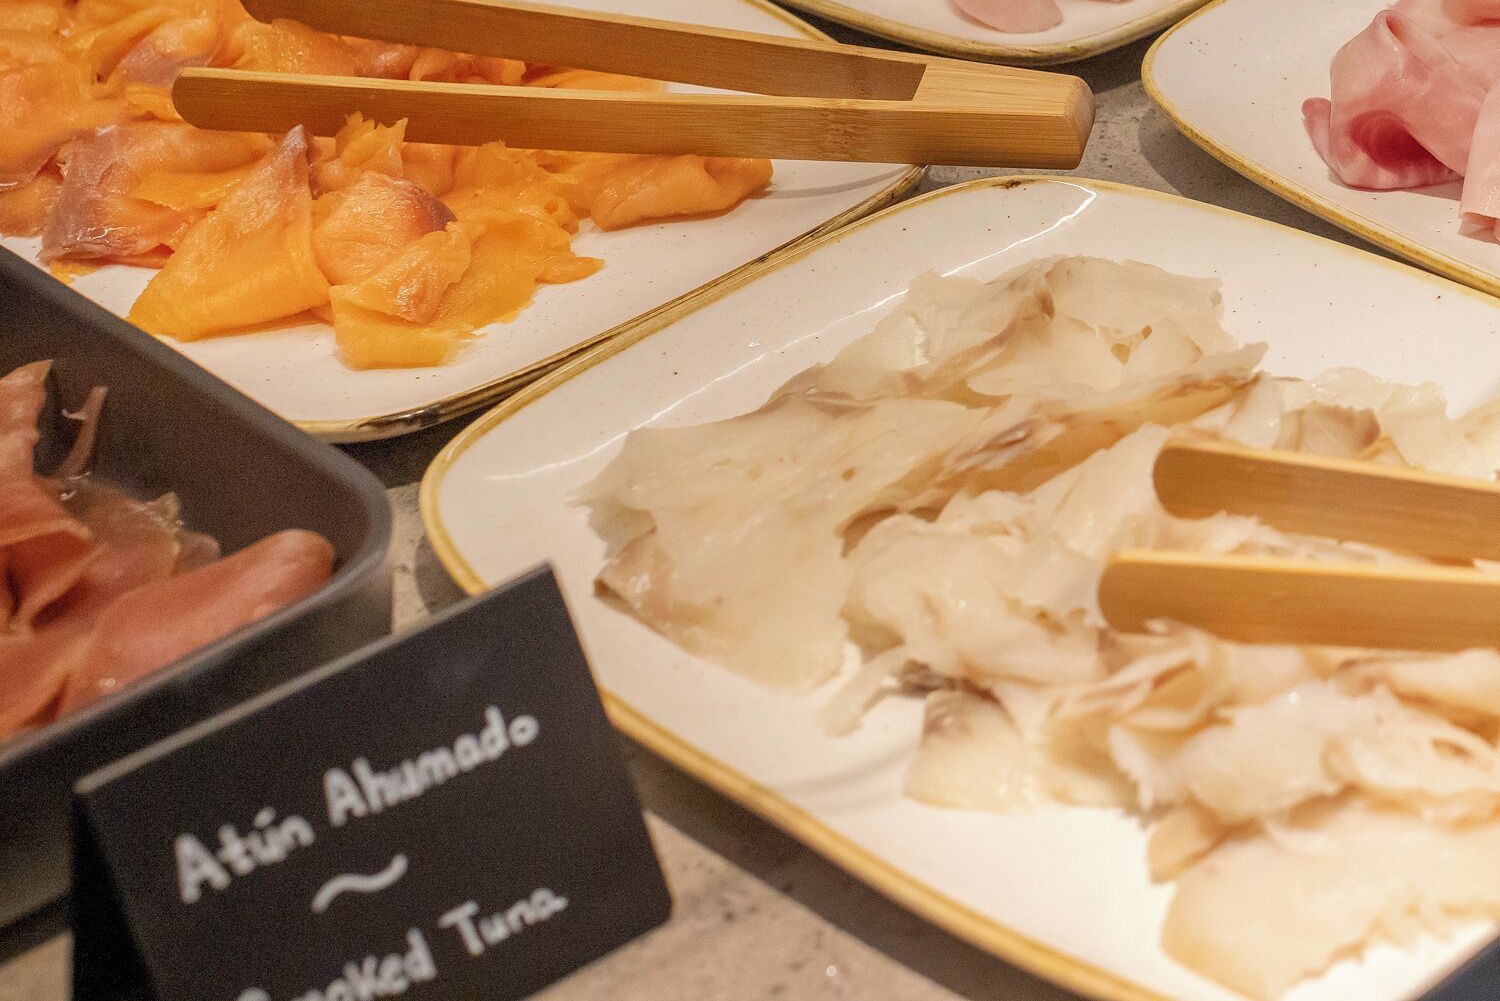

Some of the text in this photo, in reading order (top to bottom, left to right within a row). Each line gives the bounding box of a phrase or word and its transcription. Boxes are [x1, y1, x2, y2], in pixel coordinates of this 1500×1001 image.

[174, 705, 541, 903] Atún Ahumado
[438, 887, 570, 956] Tuna
